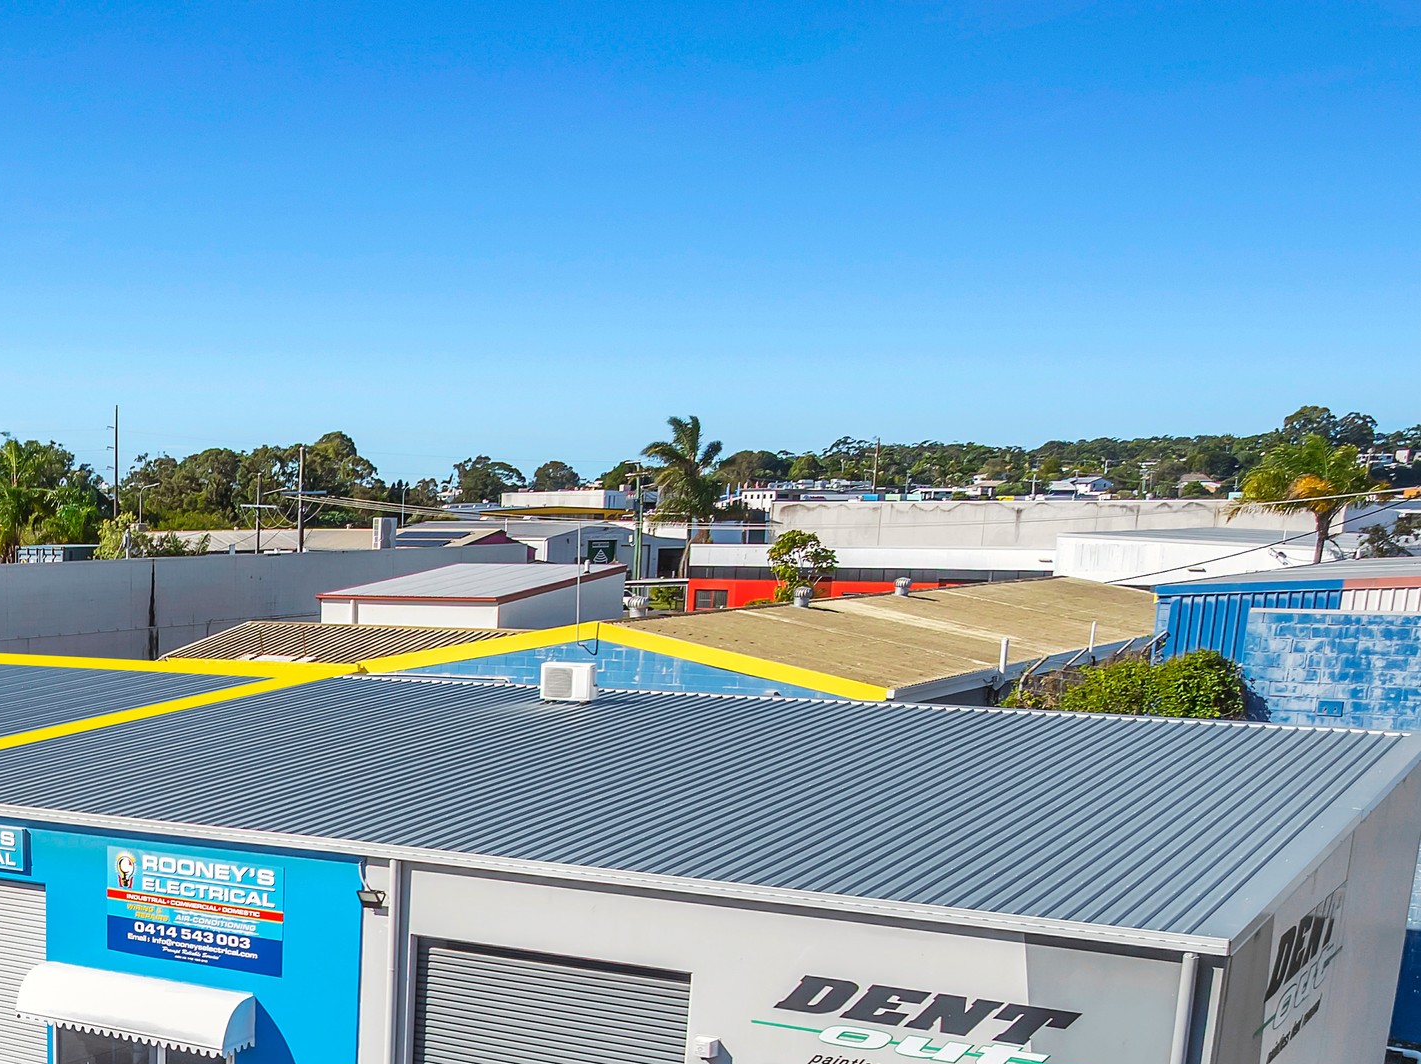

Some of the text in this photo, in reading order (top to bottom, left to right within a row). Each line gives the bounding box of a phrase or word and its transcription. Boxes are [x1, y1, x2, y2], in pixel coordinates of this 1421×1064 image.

[142, 854, 276, 887] ROONEY'S
[126, 893, 261, 918] INDUSTRIAL COMMERCIAL DOMESTIC
[142, 877, 276, 909] ELECTRICAL
[126, 903, 154, 914] WIRING
[135, 911, 169, 923] REPAIRS
[133, 921, 251, 949] 0414 543 003
[175, 914, 257, 932] AIR-CONDITIONING
[773, 974, 1083, 1046] DENT
